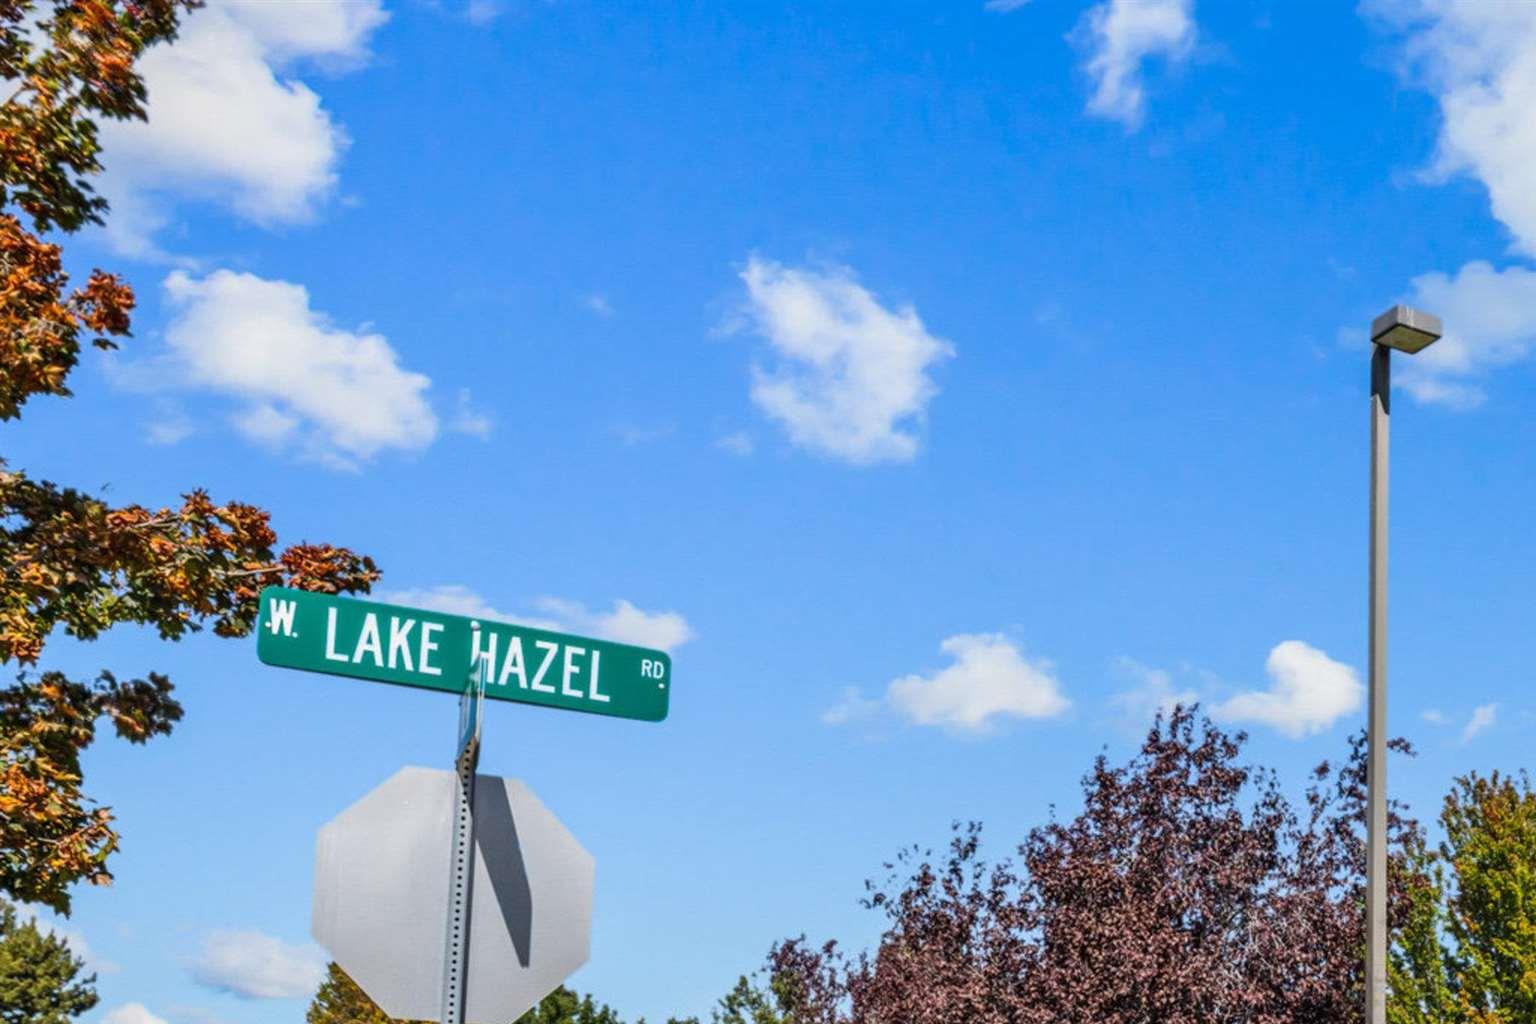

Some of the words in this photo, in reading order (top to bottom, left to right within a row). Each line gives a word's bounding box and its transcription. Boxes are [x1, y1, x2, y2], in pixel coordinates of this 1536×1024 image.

[325, 606, 445, 676] LAKE
[470, 629, 611, 702] HAZEL
[641, 659, 664, 679] RD
